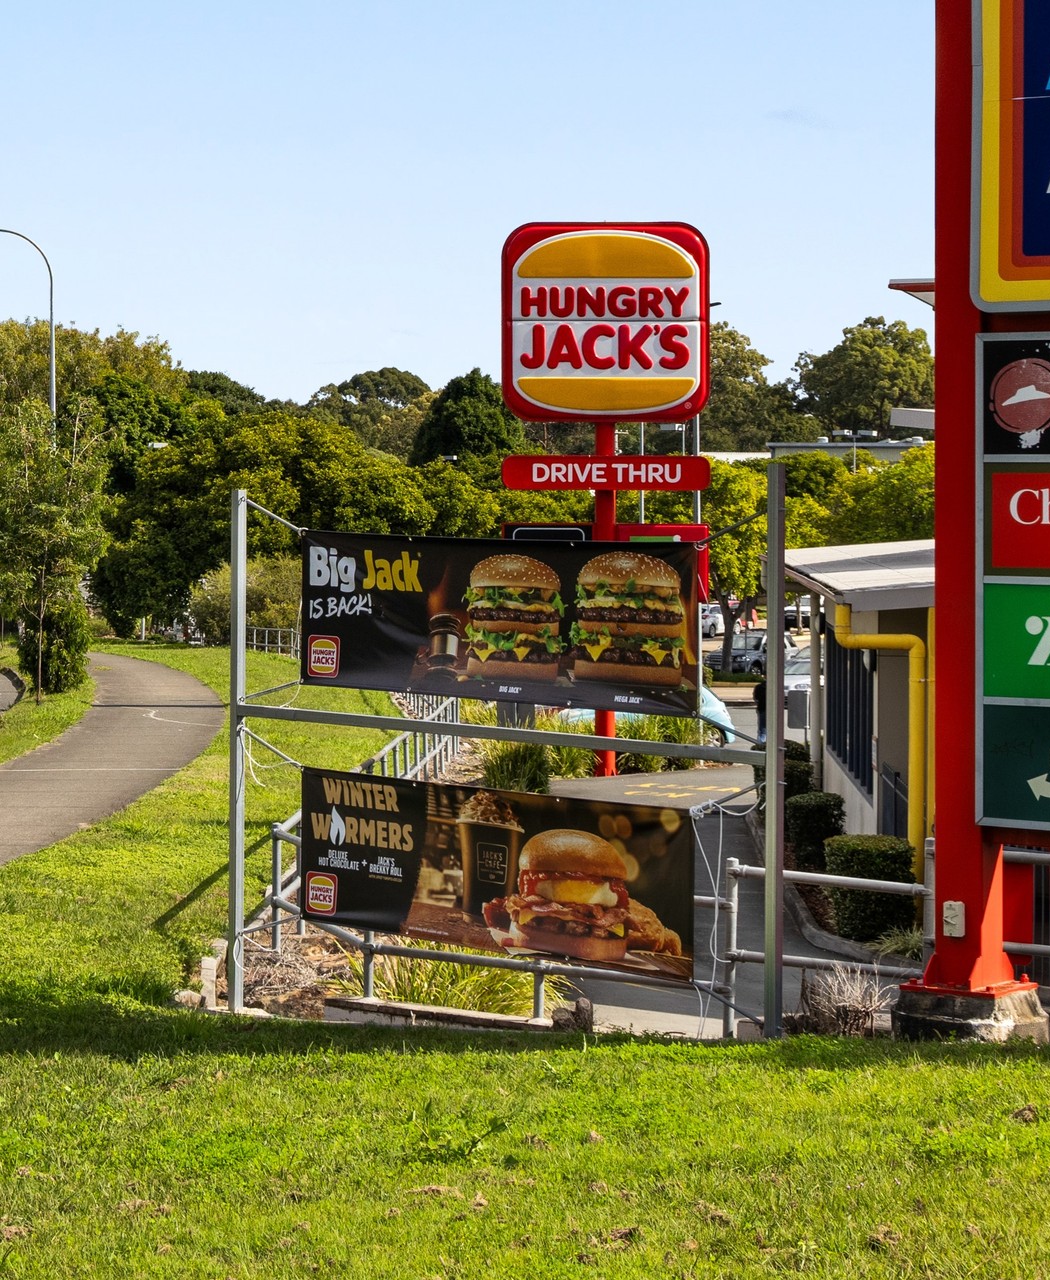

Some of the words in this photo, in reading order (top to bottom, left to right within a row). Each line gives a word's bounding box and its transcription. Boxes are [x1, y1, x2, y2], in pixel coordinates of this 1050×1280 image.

[520, 286, 690, 318] HUNGRY
[519, 323, 690, 370] JACK'S
[532, 463, 607, 483] DRIVE
[612, 463, 681, 484] THRU
[309, 545, 357, 593] Big
[362, 549, 423, 592] Jack
[309, 598, 323, 619] IS
[325, 593, 372, 617] BACK!
[312, 648, 335, 656] HUNGRY
[322, 777, 399, 812] WINTER
[318, 856, 329, 867] HOT
[330, 858, 360, 871] CHOCOLATE
[328, 849, 348, 860] DELUXE
[311, 885, 333, 894] HUNGRY
